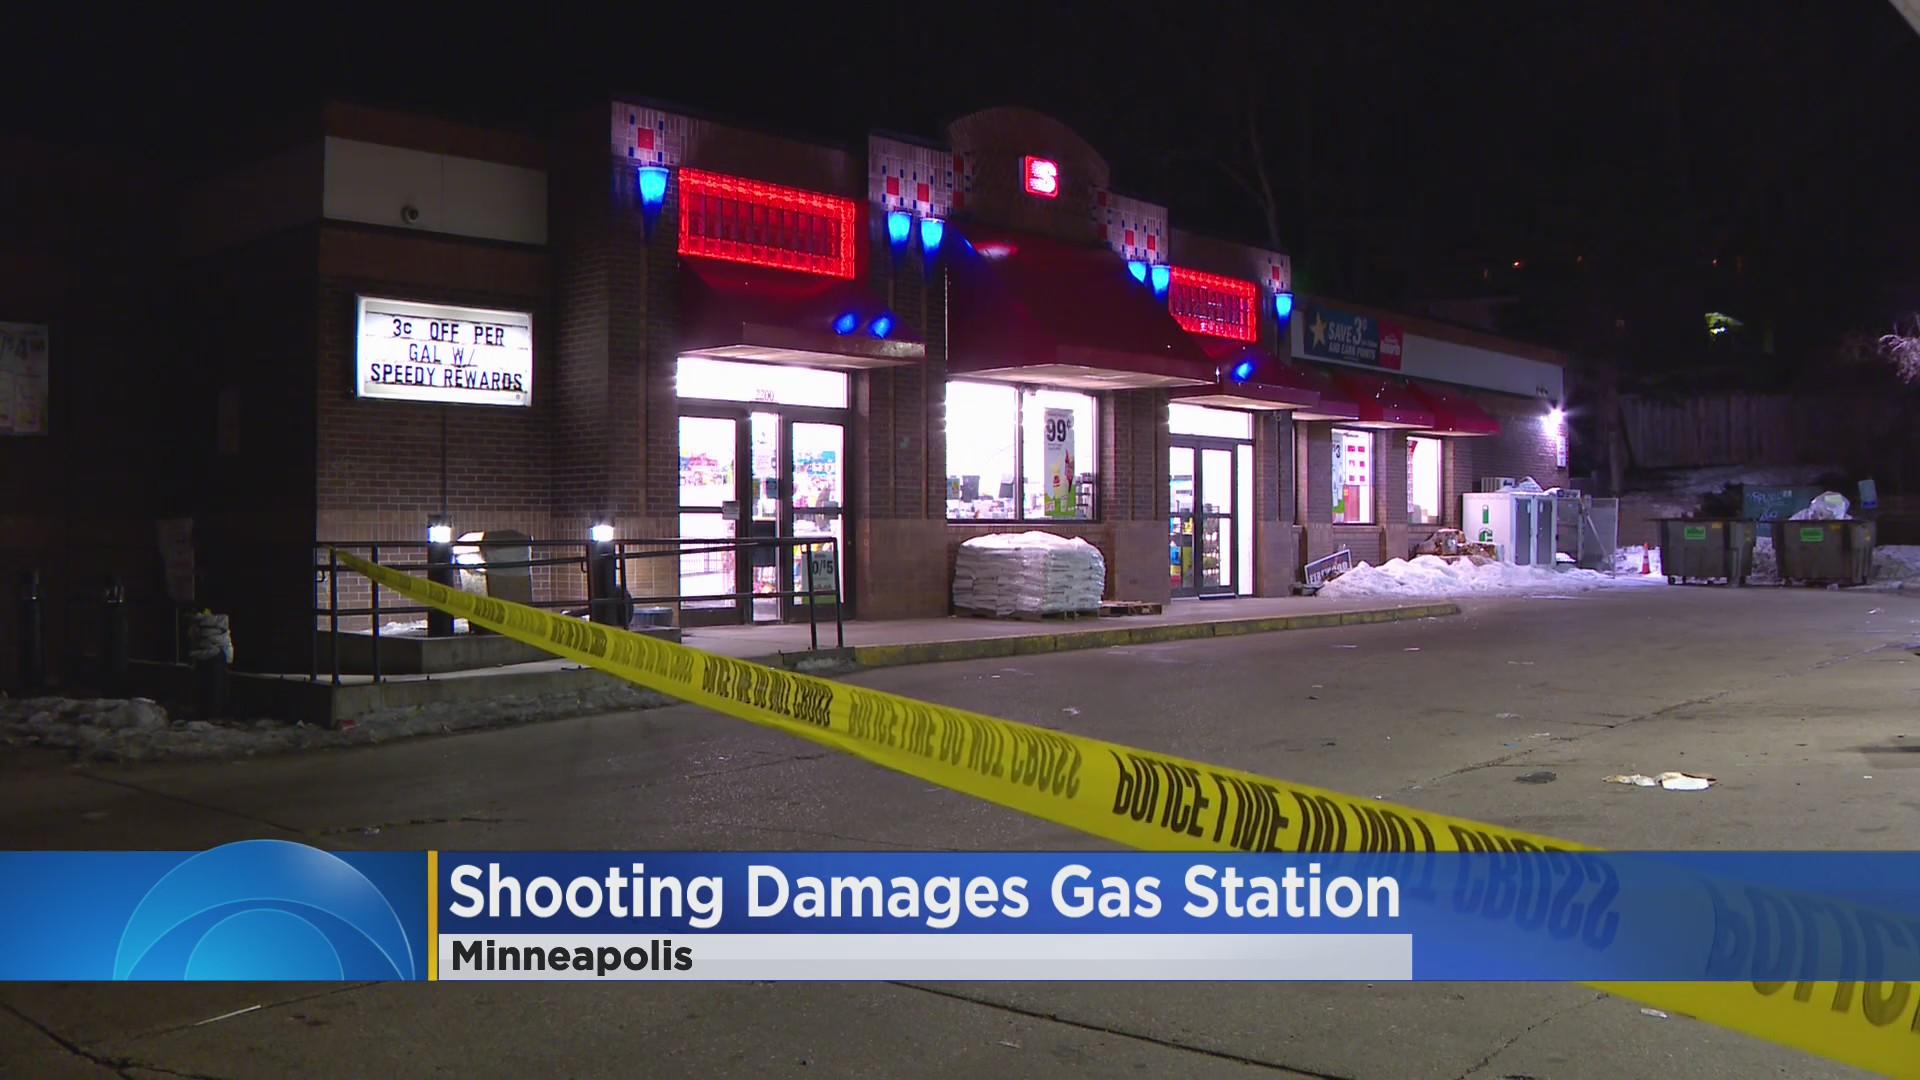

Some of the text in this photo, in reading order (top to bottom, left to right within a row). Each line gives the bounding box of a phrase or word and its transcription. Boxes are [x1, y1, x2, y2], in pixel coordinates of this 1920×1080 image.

[430, 321, 460, 343] OFF
[474, 325, 504, 347] PER
[1328, 321, 1353, 344] SAVE
[409, 343, 478, 368] GAL W/
[371, 363, 522, 391] SPEEDY REWARDS
